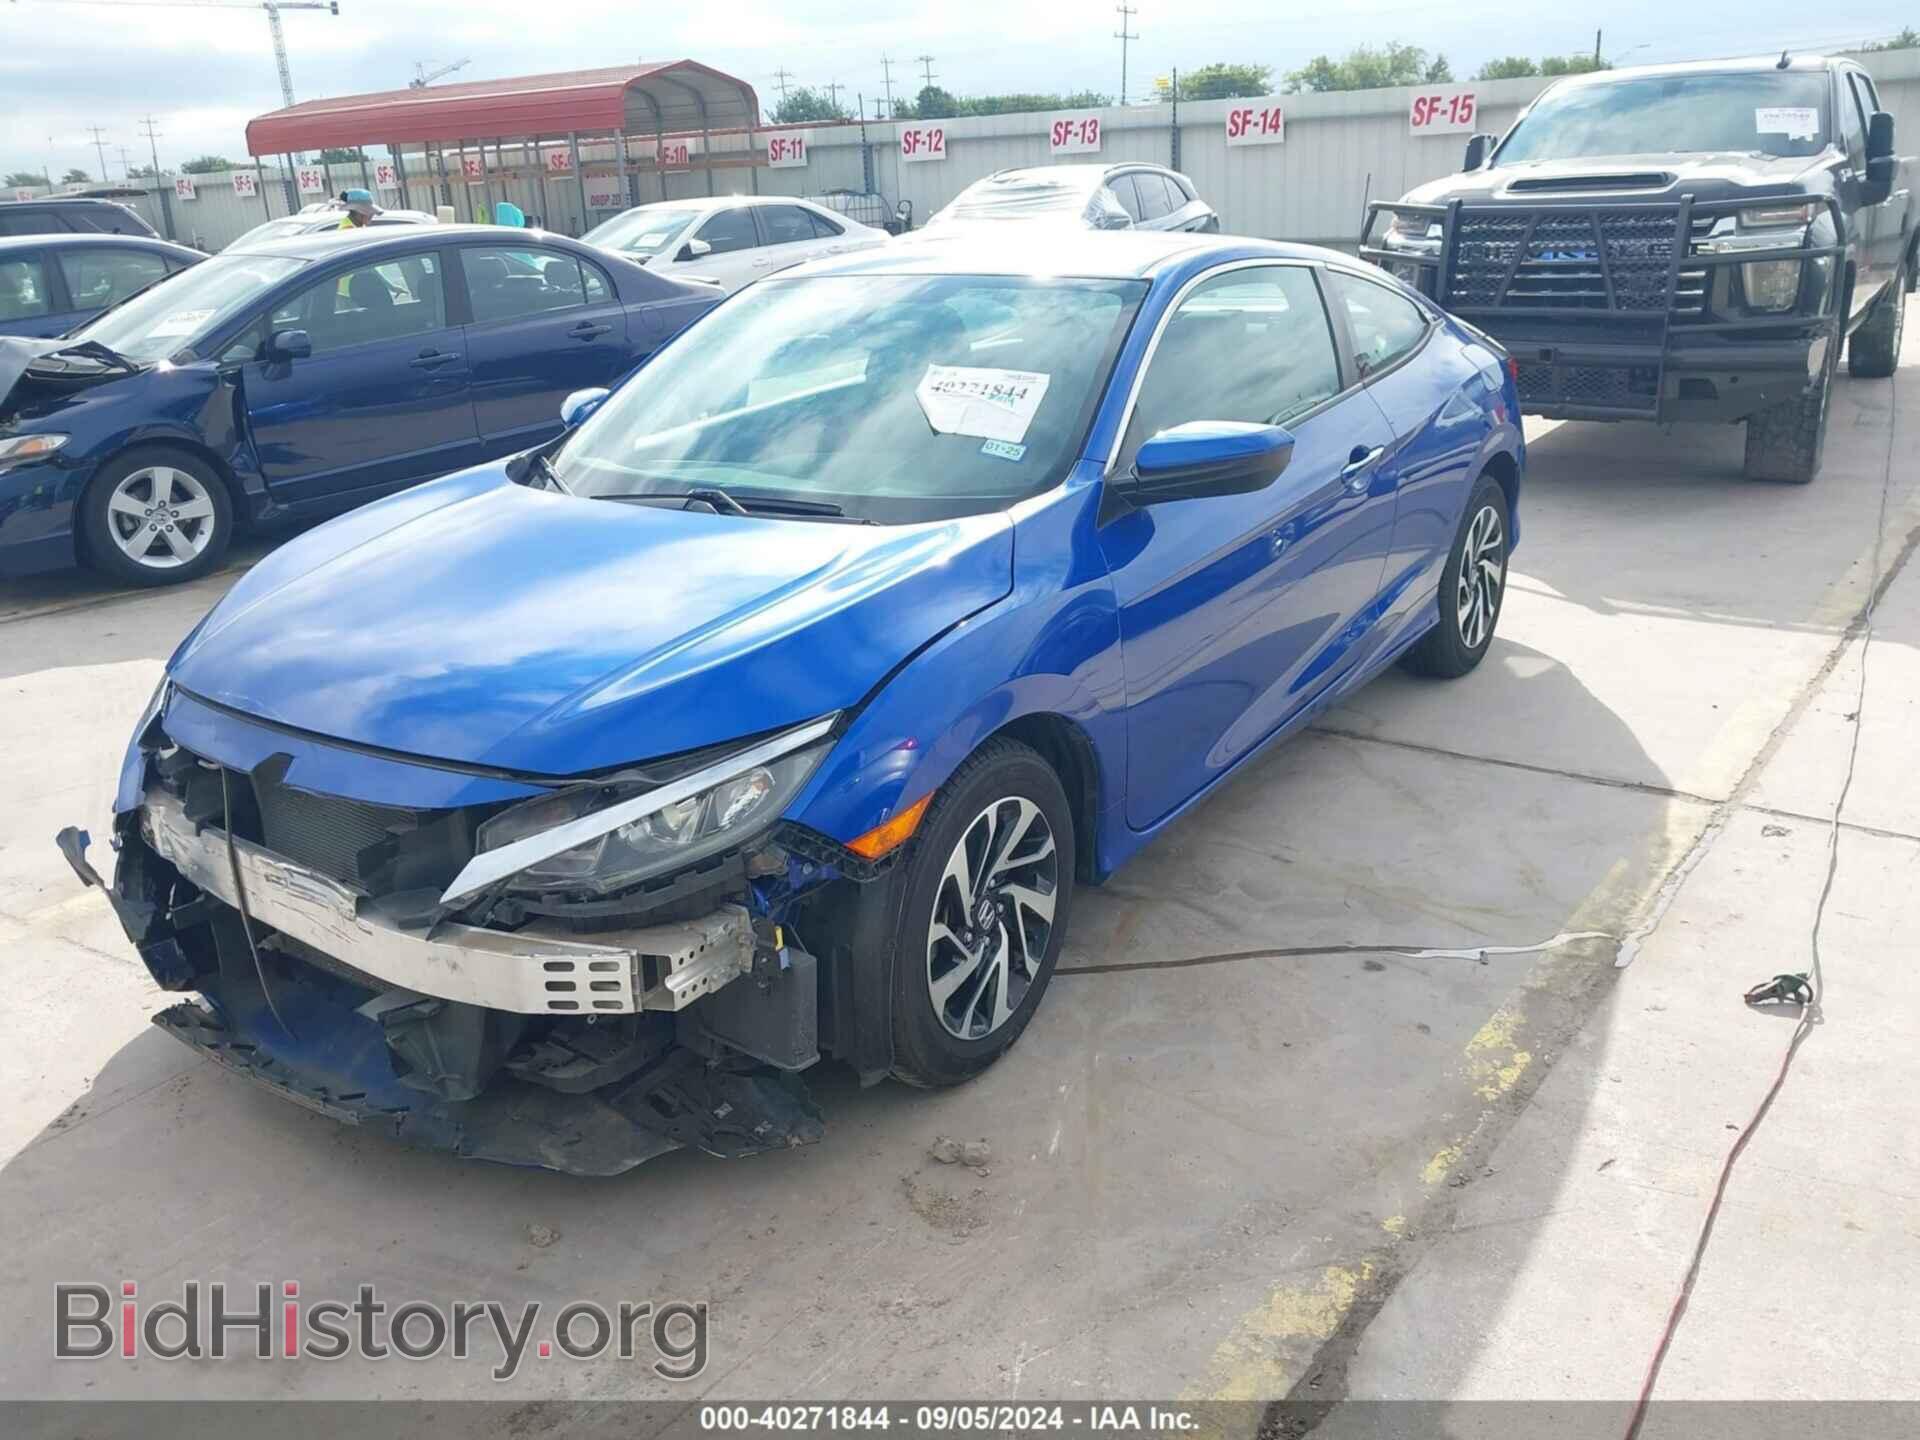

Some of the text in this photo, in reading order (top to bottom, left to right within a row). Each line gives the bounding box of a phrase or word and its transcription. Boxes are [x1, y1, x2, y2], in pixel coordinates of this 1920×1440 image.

[1228, 108, 1281, 137] SF-14
[1412, 94, 1475, 127] SF-15
[903, 129, 943, 154] SF-12
[1052, 119, 1098, 146] SF-13
[770, 138, 803, 161] SF-11
